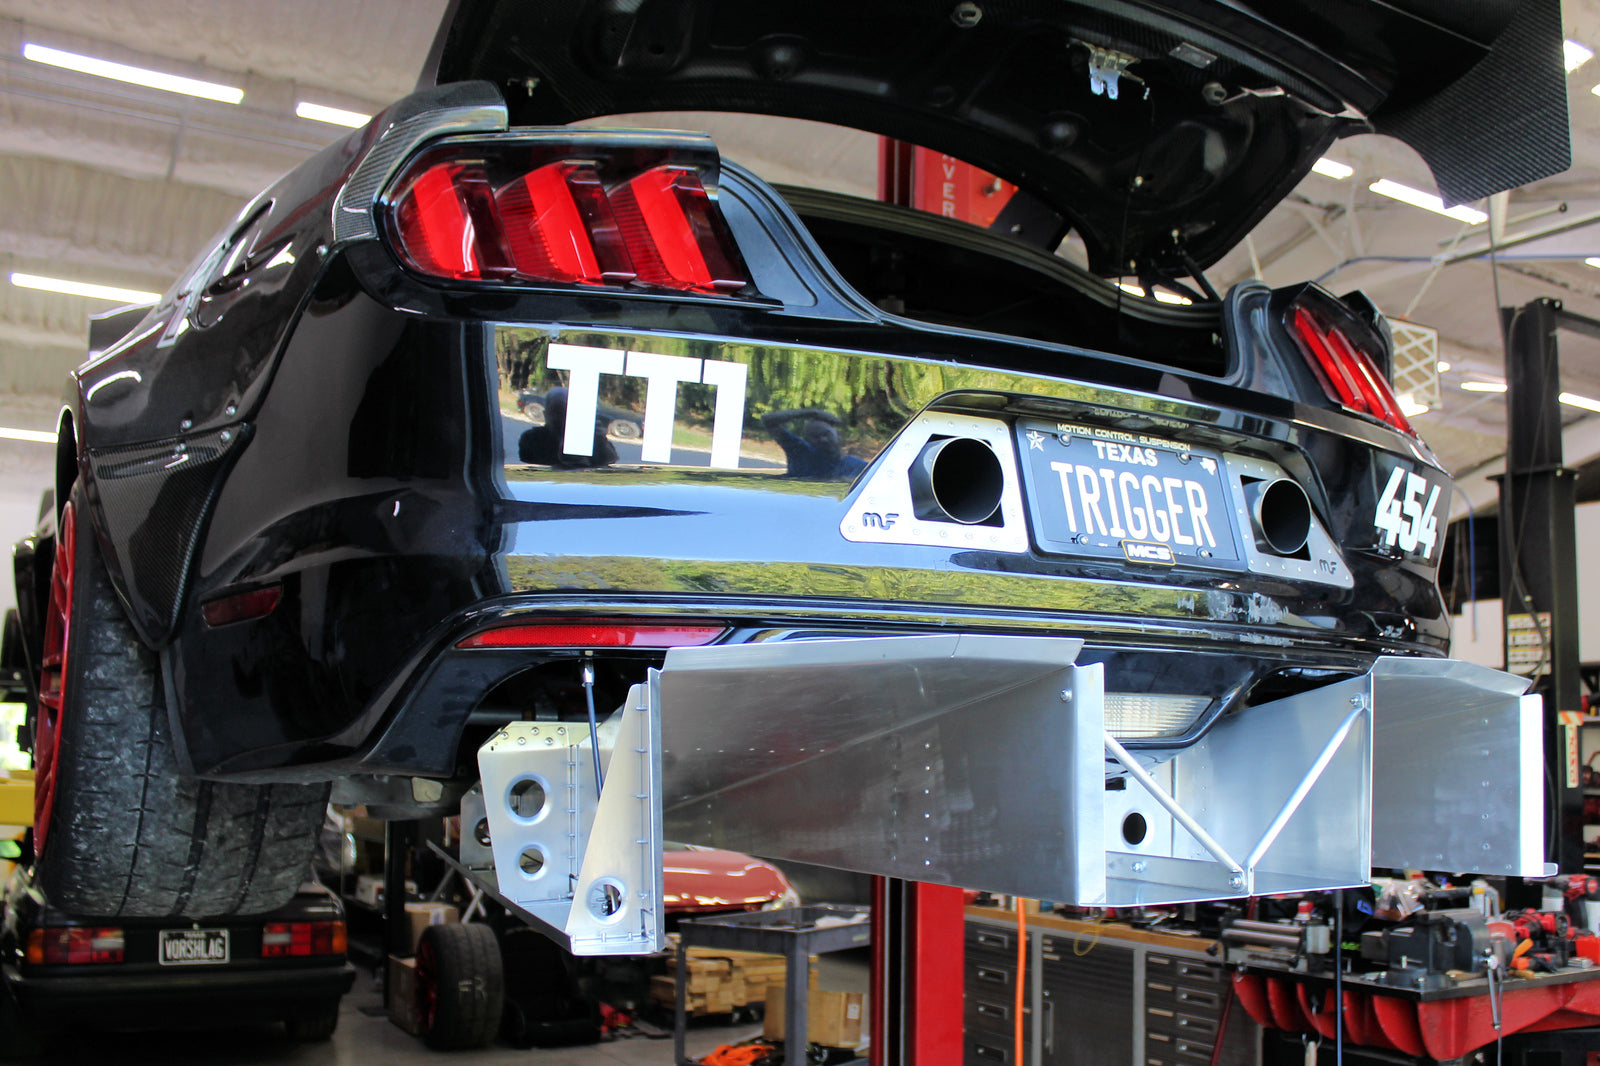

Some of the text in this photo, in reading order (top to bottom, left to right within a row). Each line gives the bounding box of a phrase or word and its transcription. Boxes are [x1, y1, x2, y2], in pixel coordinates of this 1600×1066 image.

[1057, 423, 1191, 451] MOTION CONTROL SUSPENSION
[1092, 440, 1158, 467] TEXAS
[1050, 461, 1216, 548] TRIGGER
[1374, 466, 1441, 559] 454
[1127, 543, 1171, 560] MCS
[165, 938, 225, 959] VORSHLAG
